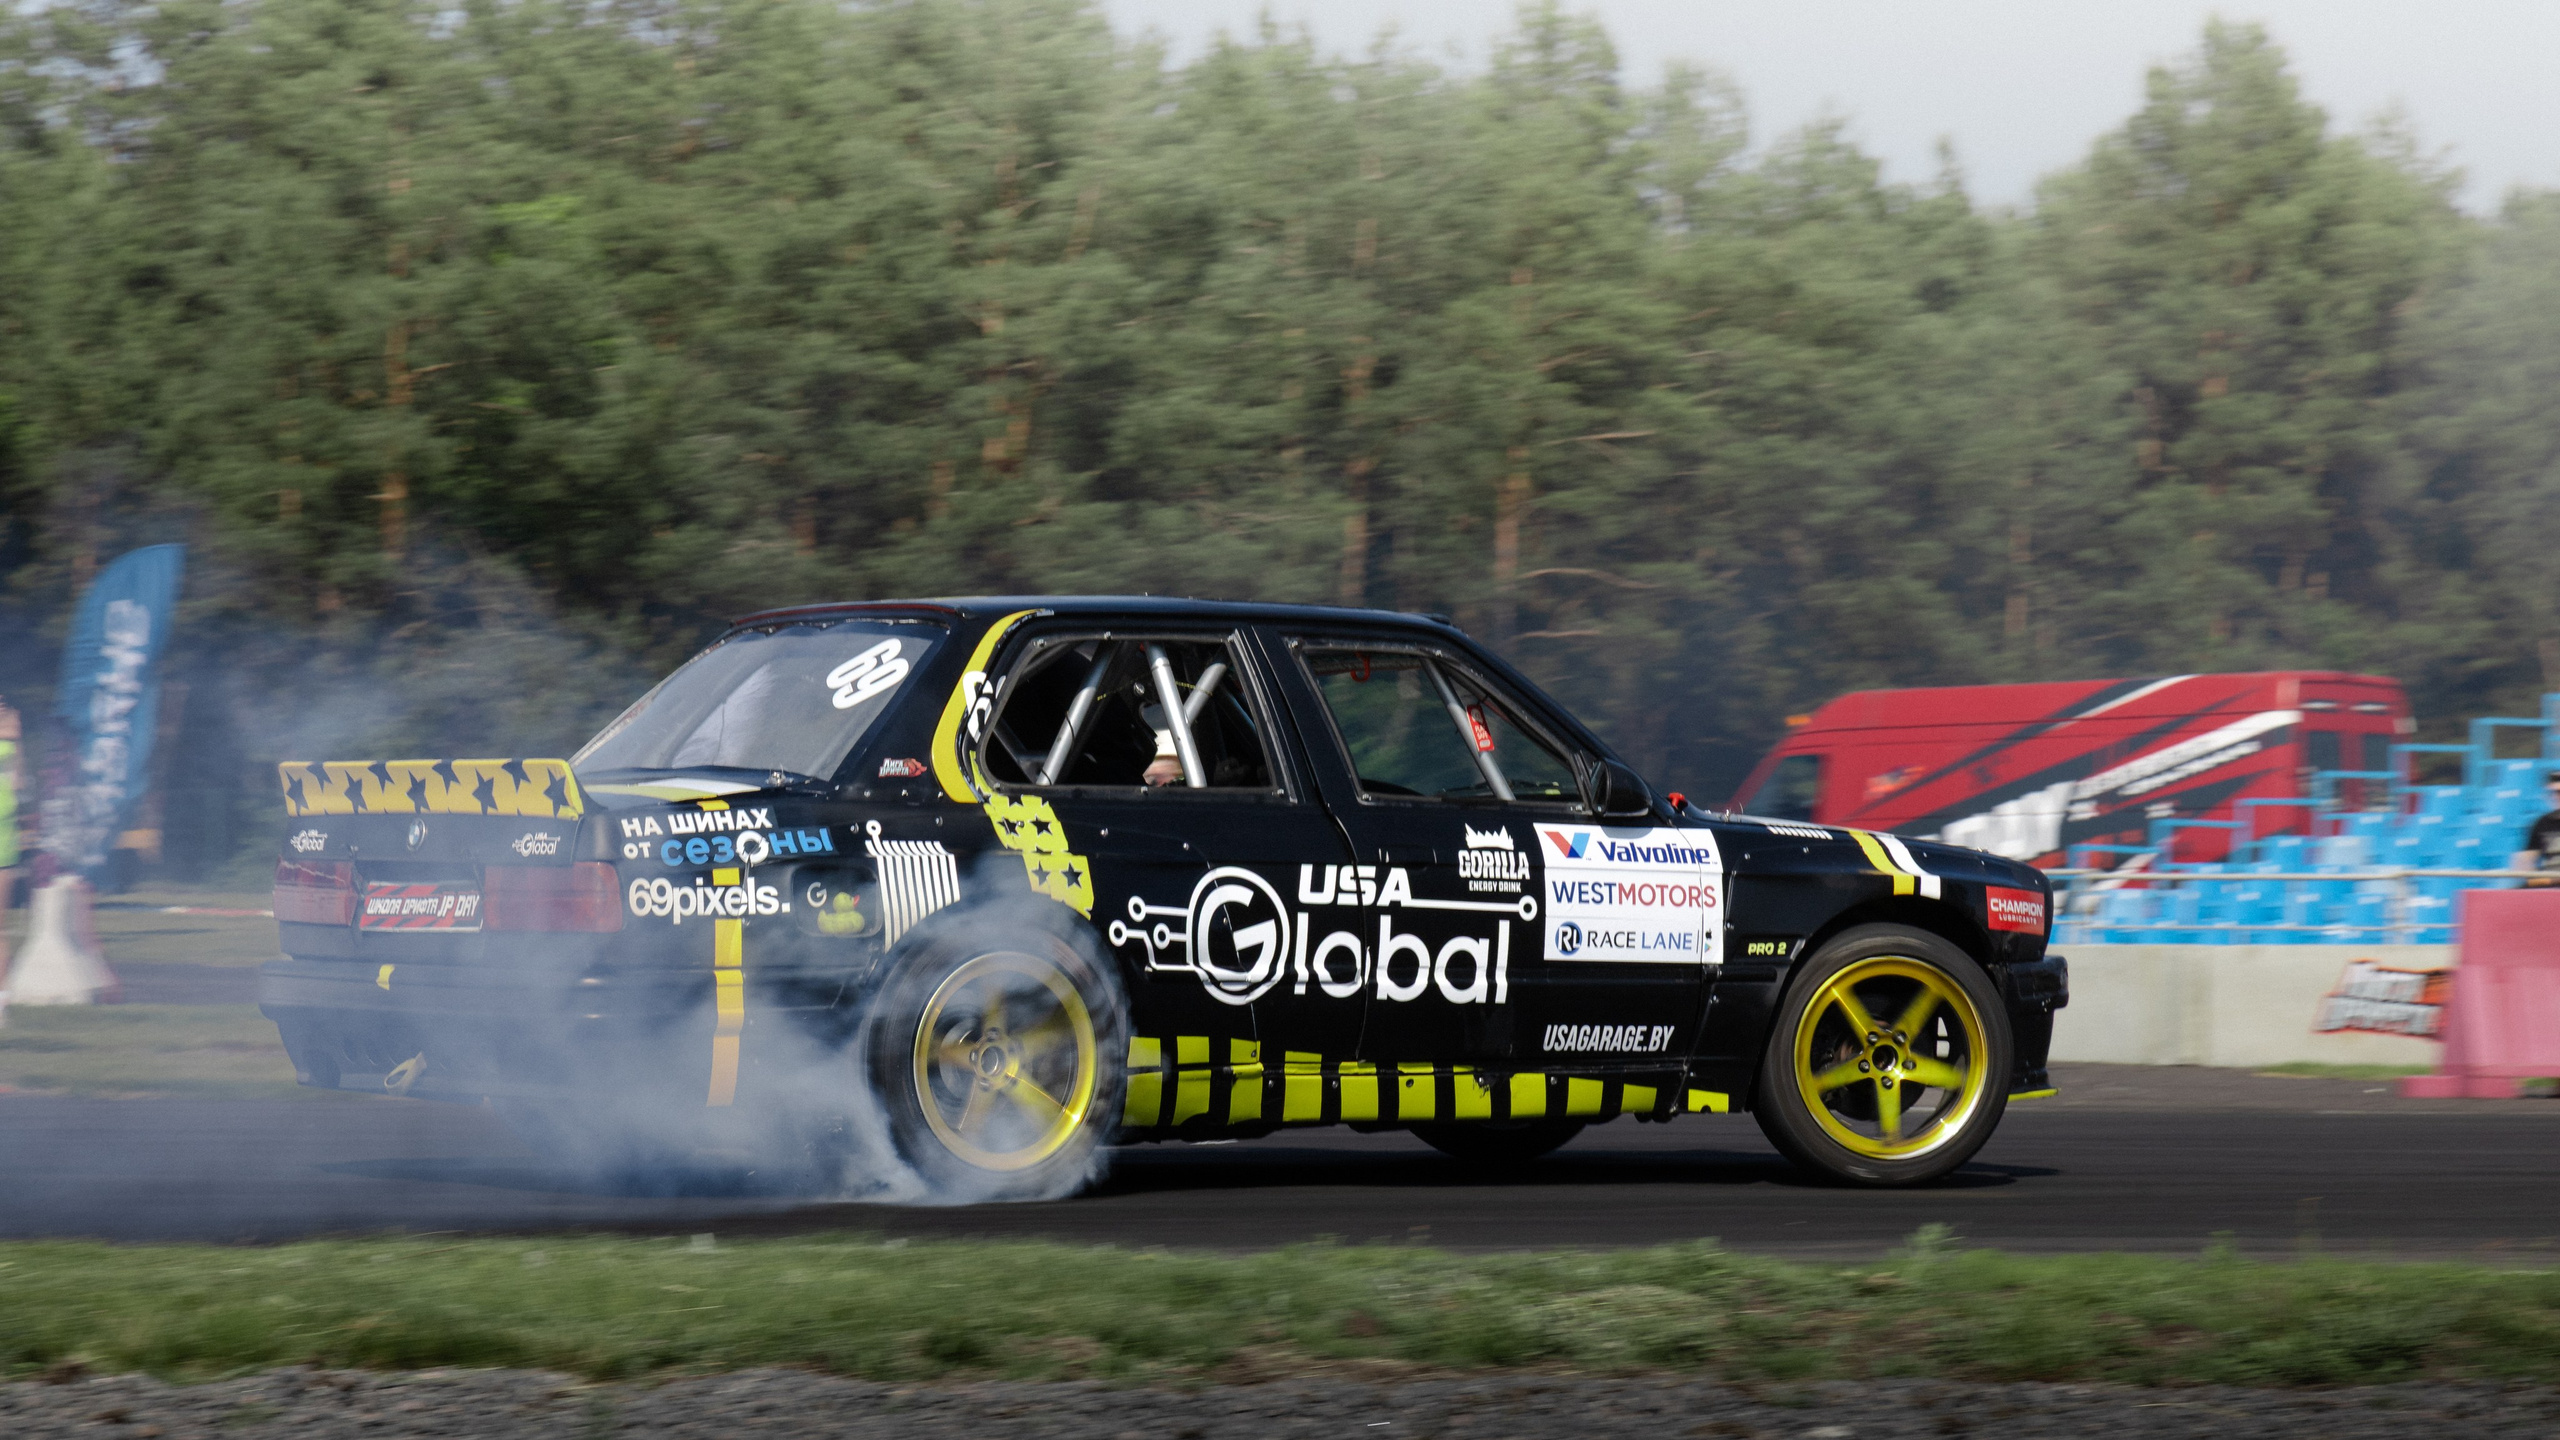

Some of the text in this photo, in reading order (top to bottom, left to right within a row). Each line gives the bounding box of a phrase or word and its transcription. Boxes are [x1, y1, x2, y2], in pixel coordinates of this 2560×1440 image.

[826, 638, 909, 709] 69
[621, 807, 773, 838] НА ШИНАХ
[522, 832, 558, 857] Global
[1597, 840, 1711, 865] Valvoline
[1458, 849, 1531, 880] GORILLA
[1298, 863, 1412, 907] USA
[1468, 880, 1521, 893] ENERGY DRINK
[1552, 880, 1717, 909] WESTMOTORS
[366, 894, 480, 917] ШКОЛА ДРИФТА JP DAY
[628, 876, 791, 925] 69pixels.
[1990, 897, 2044, 917] CHAMPION
[1998, 913, 2037, 925] LUBRICANTS
[1197, 882, 1511, 1005] Global
[1587, 931, 1693, 950] RACE LANE
[1747, 941, 1787, 956] PRO 2
[1542, 1024, 1675, 1052] USAGARAGE.BY
